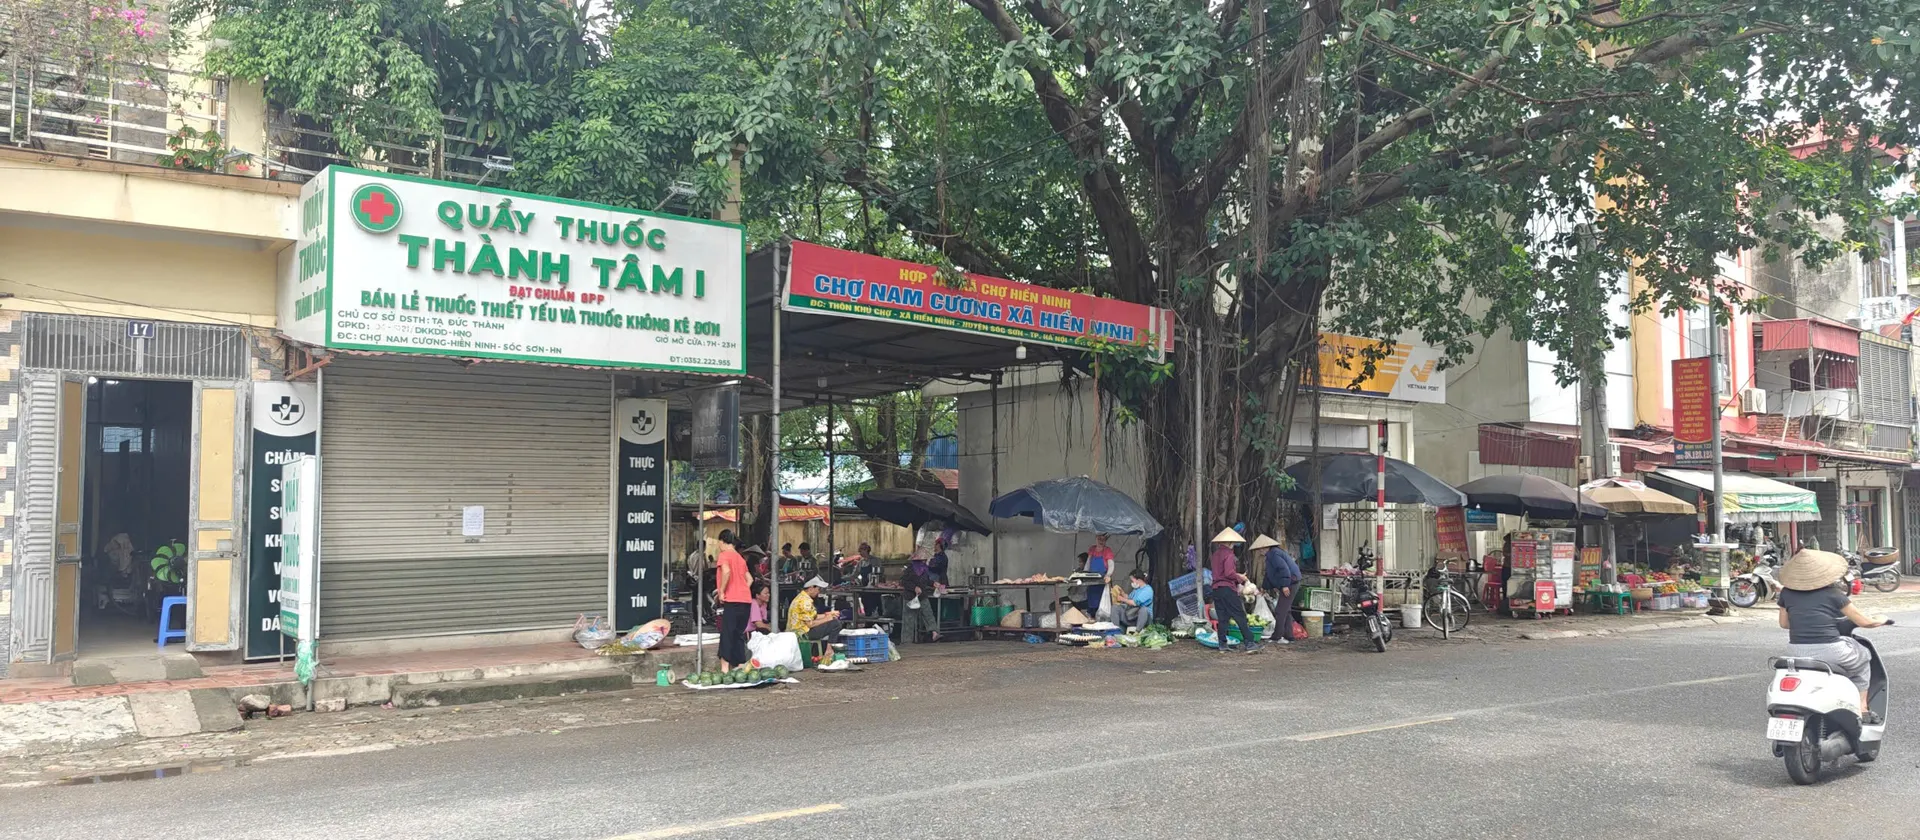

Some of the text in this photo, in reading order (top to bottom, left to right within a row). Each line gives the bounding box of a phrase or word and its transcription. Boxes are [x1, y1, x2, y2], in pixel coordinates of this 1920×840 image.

[556, 218, 666, 250] THUỐC
[398, 233, 570, 284] THÀNH
[592, 254, 683, 296] TÂM
[509, 285, 532, 299] ĐẠT
[900, 268, 928, 285] HỢP
[981, 283, 1007, 299] CHỢ
[1010, 288, 1039, 303] HIỀN
[1042, 294, 1071, 309] NINH
[361, 288, 721, 337] BÁN LẺ THUỐC THIẾT YẾU VÀ THUỐC KHÔNG KÊ ĐƠN
[814, 274, 865, 302] CHỢ
[869, 282, 923, 308] NAM
[930, 292, 1002, 321] CƯƠNG
[1007, 304, 1034, 326] XÃ
[1040, 309, 1084, 334] HIỀN
[1090, 319, 1134, 341] NINH
[338, 309, 359, 318] CHỦ
[363, 312, 378, 320] CƠ
[382, 311, 395, 321] SỞ
[448, 317, 468, 327] ĐỨC
[472, 320, 505, 330] THÀNH
[338, 321, 370, 330] GPKD:
[828, 301, 852, 312] THÔN
[874, 308, 892, 317] CHỢ
[1008, 328, 1023, 336] SƠN
[133, 323, 149, 335] 17
[337, 332, 357, 340] ĐC:
[360, 334, 381, 345] CHỢ
[629, 456, 654, 471] THỰC
[626, 480, 656, 496] PHẨM
[627, 509, 655, 524] CHỨC
[626, 537, 655, 552] NĂNG
[632, 568, 646, 580] UY
[631, 593, 647, 608] TÍN
